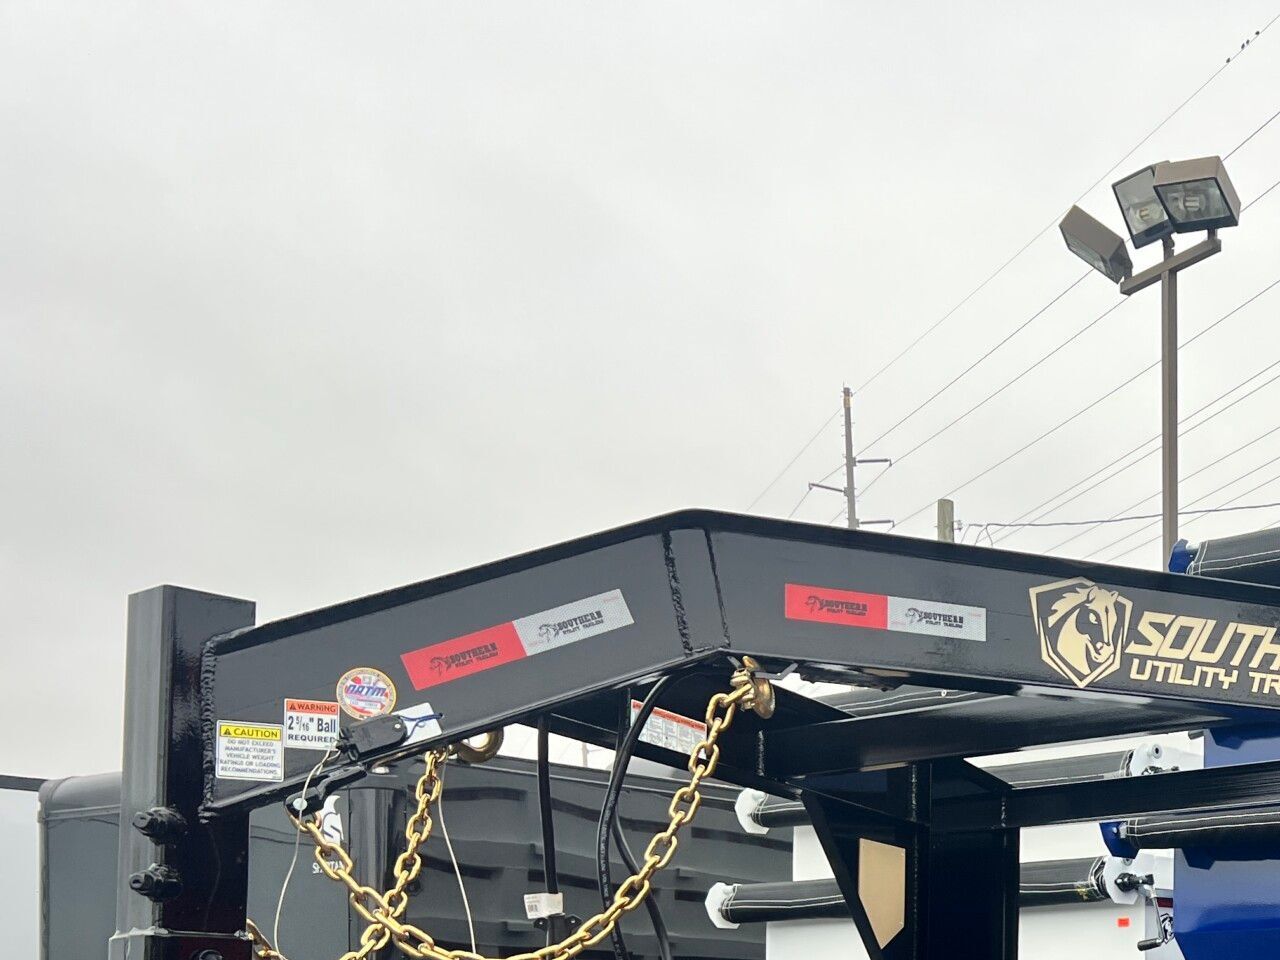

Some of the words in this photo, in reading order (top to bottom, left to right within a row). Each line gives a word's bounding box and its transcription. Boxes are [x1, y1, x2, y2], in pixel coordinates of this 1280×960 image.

[557, 610, 603, 630] SOUTHERN
[923, 611, 964, 624] SOUTHERN
[450, 642, 497, 664] SOUTHERN
[1129, 658, 1239, 690] UTILITY
[297, 703, 336, 713] WARNING
[233, 727, 278, 738] CAUTION
[288, 715, 294, 731] 2
[317, 717, 336, 733] Ball
